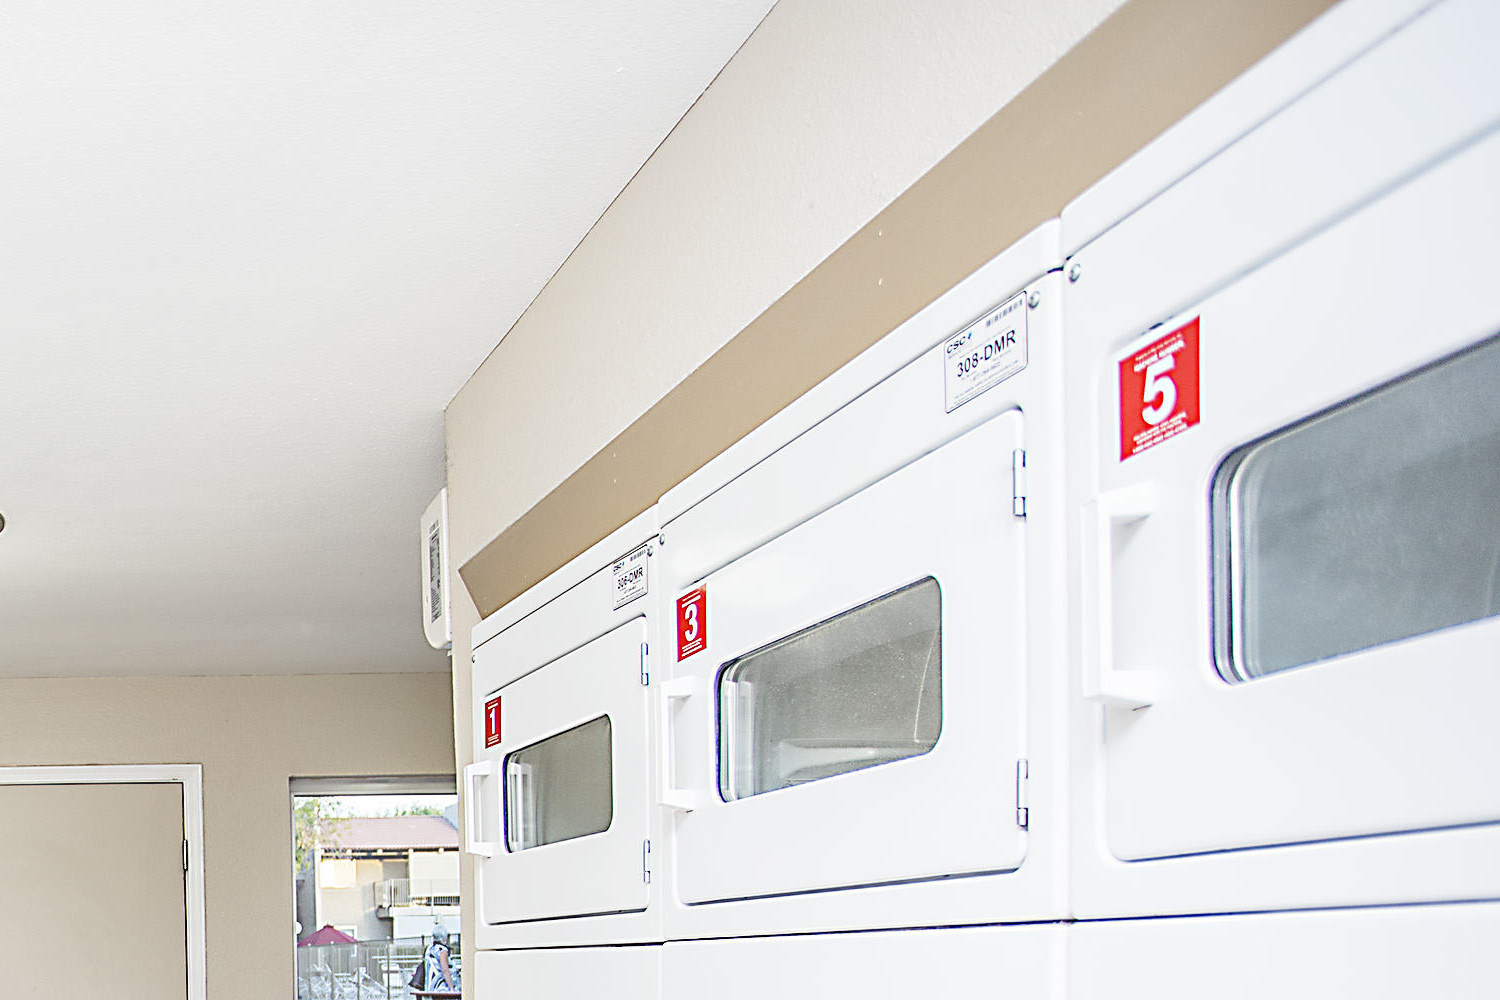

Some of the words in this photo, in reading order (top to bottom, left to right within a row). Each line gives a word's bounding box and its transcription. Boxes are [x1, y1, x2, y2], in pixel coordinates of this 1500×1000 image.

[957, 329, 1016, 378] 308-DMR
[1142, 353, 1177, 426] 5
[684, 603, 698, 642] 3
[489, 707, 496, 735] 1
